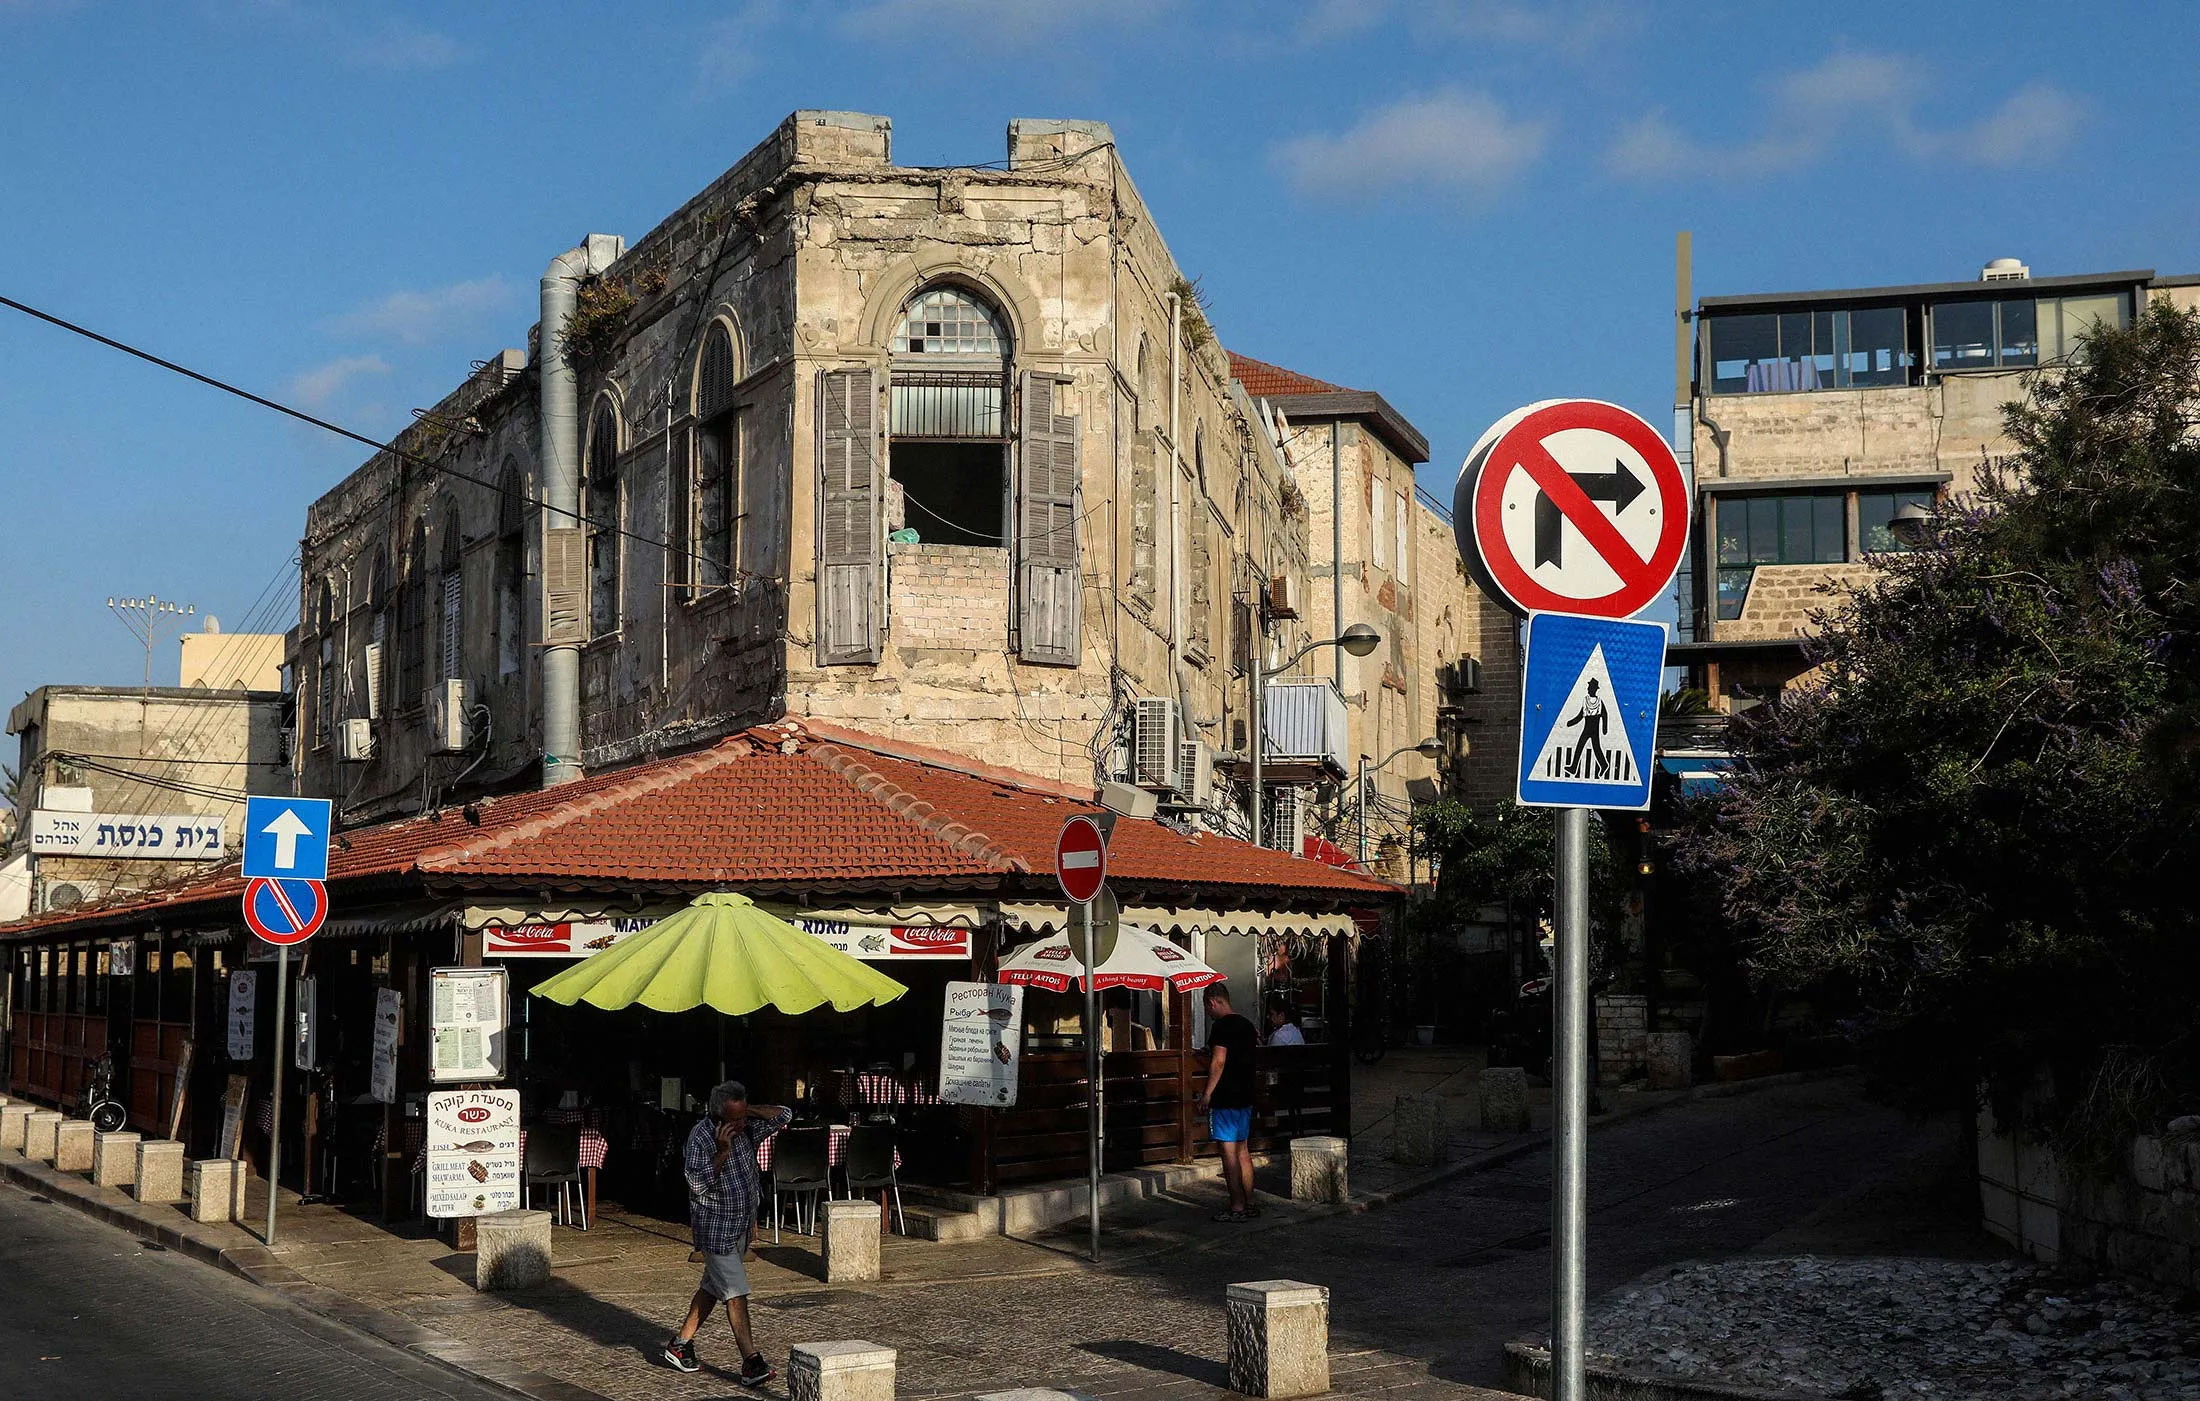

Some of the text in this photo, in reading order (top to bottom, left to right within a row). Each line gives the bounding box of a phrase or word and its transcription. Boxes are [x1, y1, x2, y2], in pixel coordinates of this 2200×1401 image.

[53, 819, 80, 831] אהל
[34, 833, 79, 845] אברהם
[96, 823, 220, 849] בית כנסת
[1035, 973, 1061, 985] ARTOIS
[1126, 976, 1148, 985] beauty
[951, 987, 1016, 1006] Ресторан Кука
[949, 1007, 971, 1017] Рыба
[434, 1093, 514, 1112] מסעדת קוקה
[461, 1110, 488, 1120] כשר
[433, 1115, 514, 1135] KUKA RESTAURANT
[499, 1141, 515, 1149] דגים
[432, 1162, 466, 1171] GRILL MEAT
[485, 1160, 515, 1169] גריל בשרים
[432, 1173, 465, 1182] SHAWARMA
[432, 1204, 455, 1213] PLATTER
